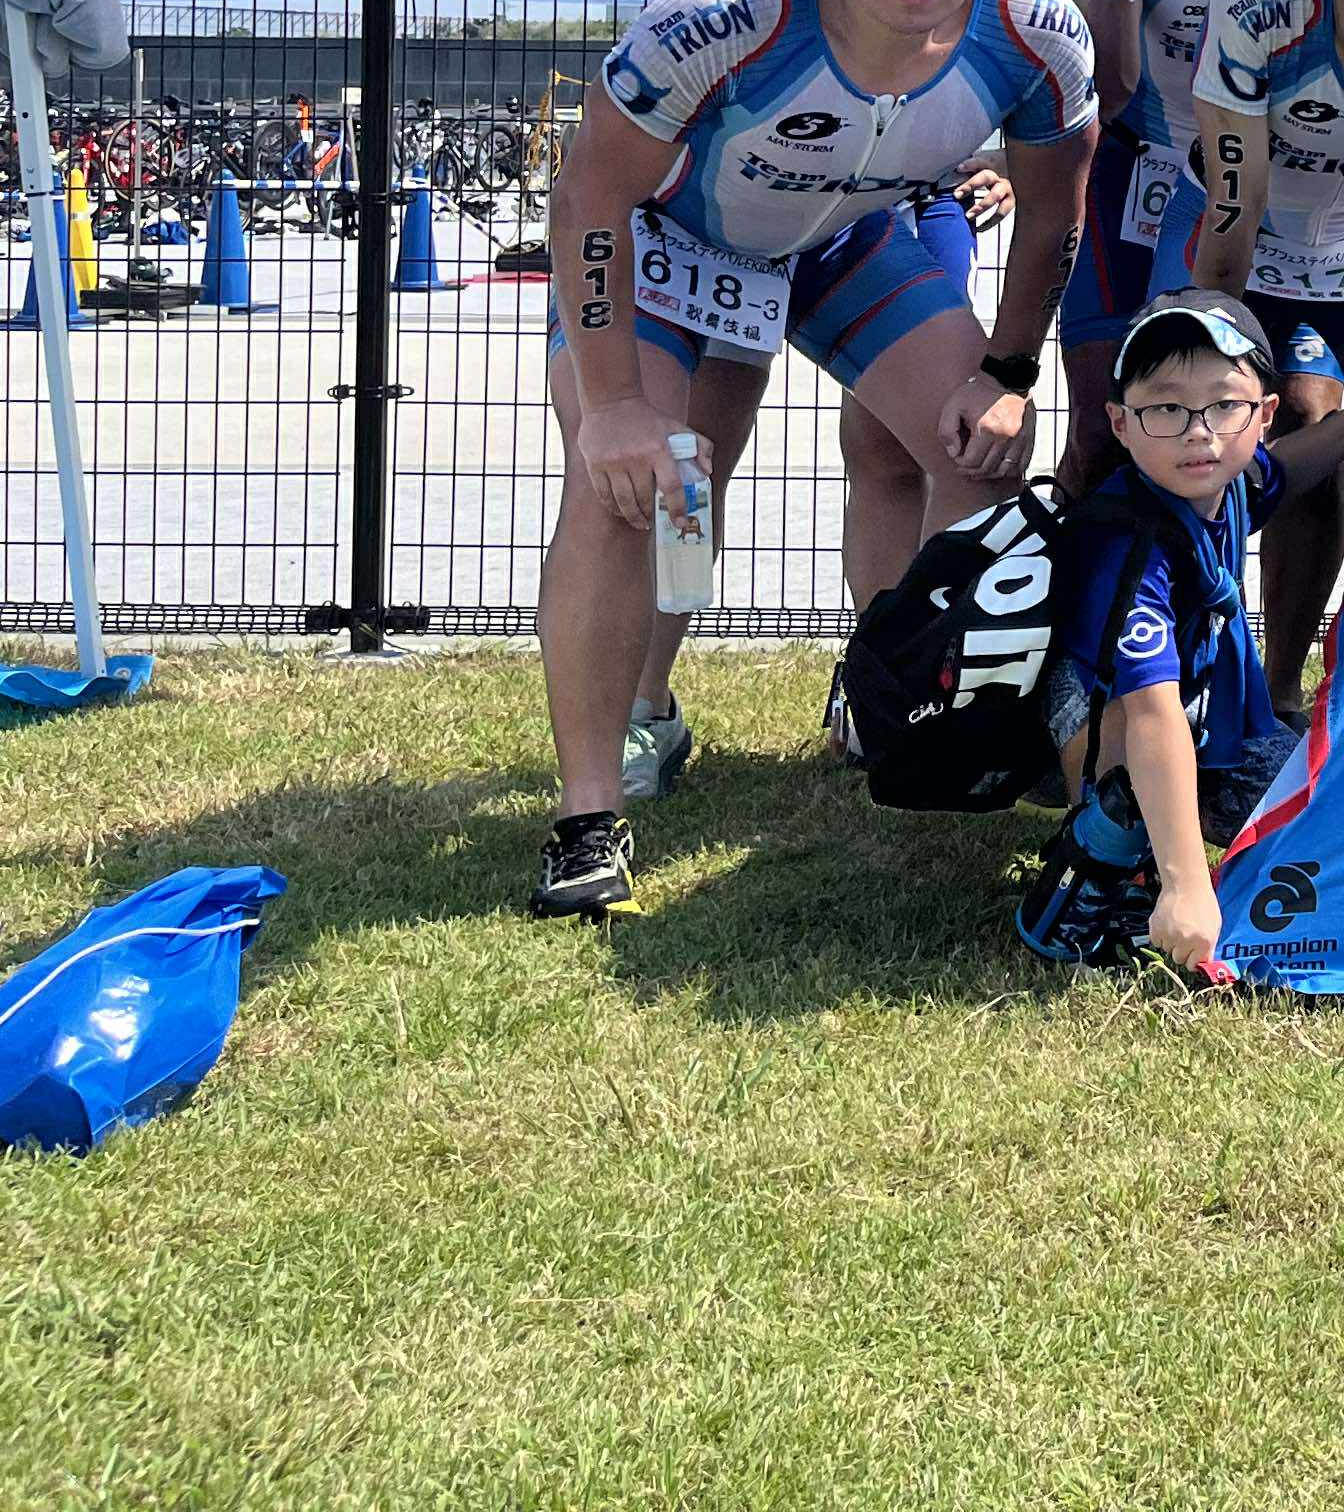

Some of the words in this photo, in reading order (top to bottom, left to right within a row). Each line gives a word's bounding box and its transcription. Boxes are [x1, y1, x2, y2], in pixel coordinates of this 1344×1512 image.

[649, 10, 685, 37] Team
[747, 152, 827, 182] Team
[1215, 133, 1244, 236] 617
[580, 229, 615, 330] 618
[641, 249, 780, 322] 618-3
[1221, 936, 1339, 962] Champion
